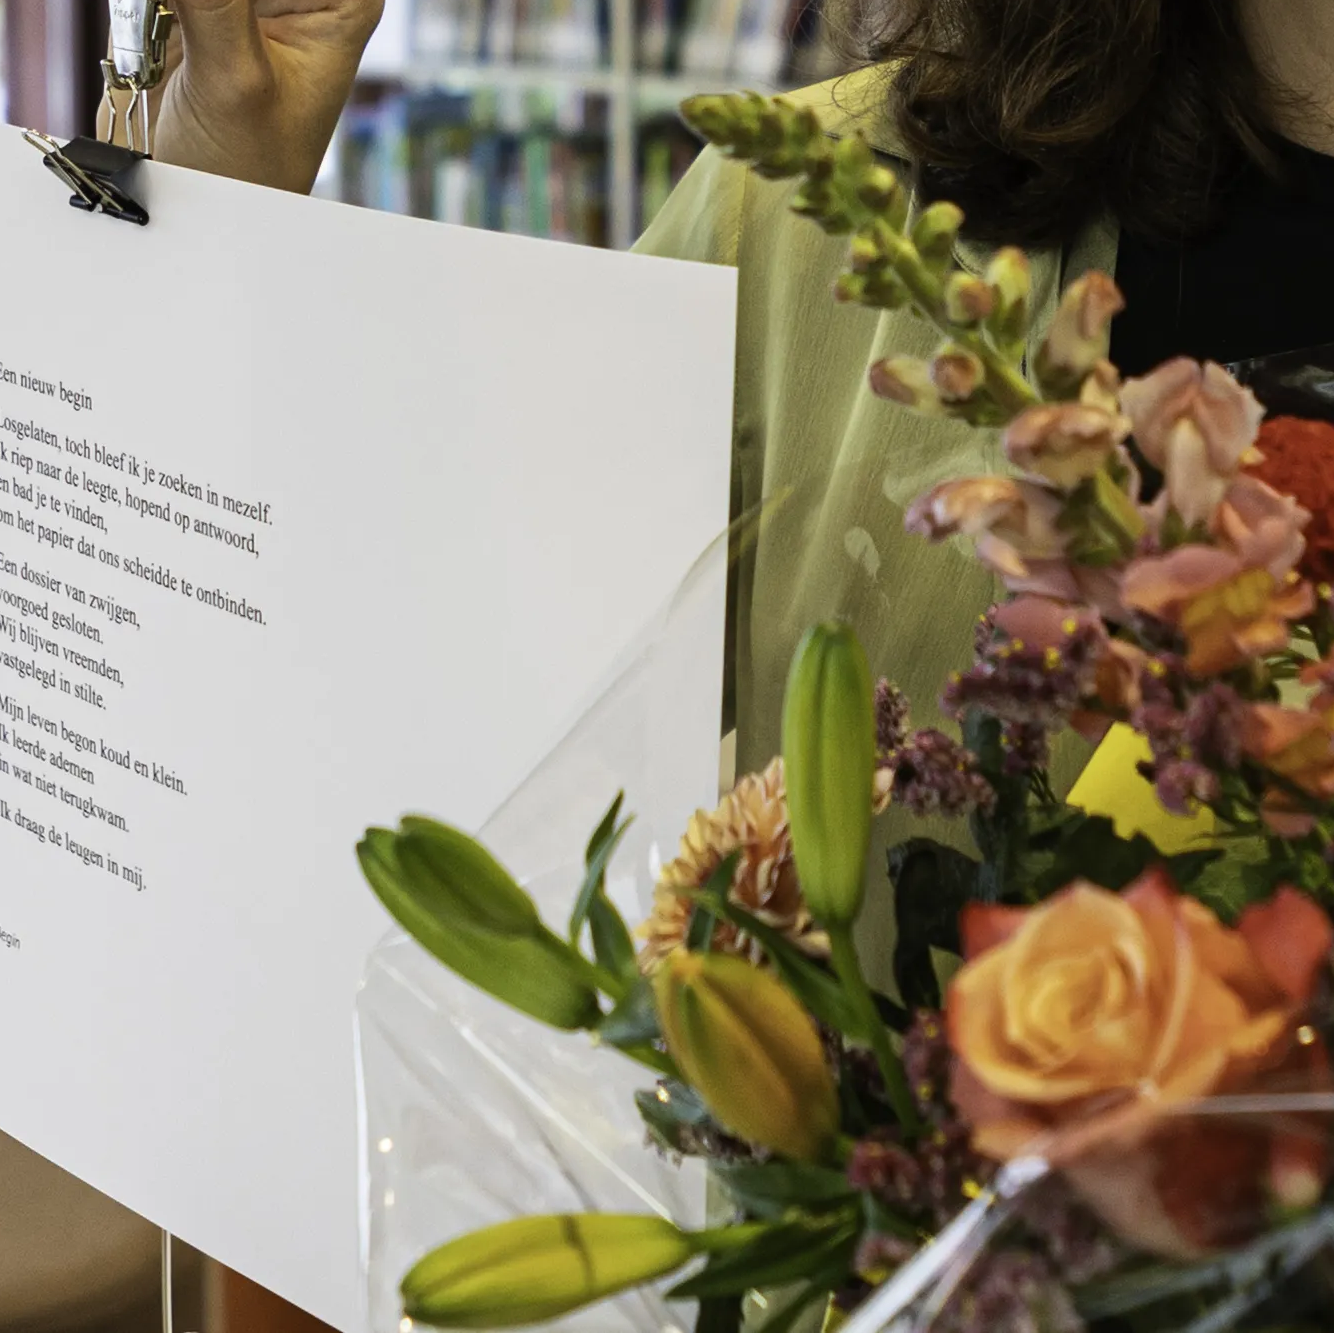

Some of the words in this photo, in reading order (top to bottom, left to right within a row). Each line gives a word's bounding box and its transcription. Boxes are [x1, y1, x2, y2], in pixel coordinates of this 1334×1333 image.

[20, 371, 56, 397] nieuw
[59, 381, 92, 411] begin
[11, 447, 33, 474] riep
[36, 460, 62, 481] naar
[65, 466, 79, 487] de
[83, 471, 121, 507] leegte,
[125, 487, 170, 522] hopend
[174, 512, 190, 534] op
[194, 519, 259, 559] antwoord,
[13, 477, 33, 502] bad
[35, 486, 47, 510] je
[50, 495, 61, 513] te
[64, 502, 108, 535] vinden,
[65, 436, 90, 459] toch
[94, 443, 127, 472] bleef
[128, 455, 140, 478] ik
[142, 461, 155, 485] je
[158, 472, 203, 500] zoeken
[207, 484, 219, 506] in
[223, 496, 272, 525] mezelf.
[17, 510, 34, 535] het
[38, 524, 74, 550] papier
[77, 536, 95, 559] dat
[99, 549, 119, 568] ons
[123, 557, 177, 591] scheidde
[181, 578, 193, 597] te
[196, 587, 266, 625] ontbinden.
[20, 562, 62, 594] dossier
[64, 584, 86, 604] van
[89, 594, 140, 631] zwijgen,
[19, 623, 59, 657] blijven
[62, 647, 124, 688] vreemden,
[52, 611, 103, 644] gesloten.
[60, 672, 71, 694] in
[74, 683, 106, 710] stilte.
[12, 729, 46, 761] leerde
[50, 751, 94, 785] ademen
[27, 705, 57, 736] leven
[61, 720, 97, 754] begon
[100, 738, 131, 769] koud
[134, 760, 149, 778] en
[153, 762, 187, 796] klein.
[0, 753, 9, 774] in
[12, 765, 32, 786] wat
[35, 774, 57, 798] niet
[60, 787, 129, 832] terugkwam.
[0, 799, 12, 822] Ik
[14, 808, 45, 843] draag
[48, 825, 62, 847] de
[65, 832, 104, 868] leugen
[107, 853, 119, 875] in
[122, 866, 146, 891] mij.
